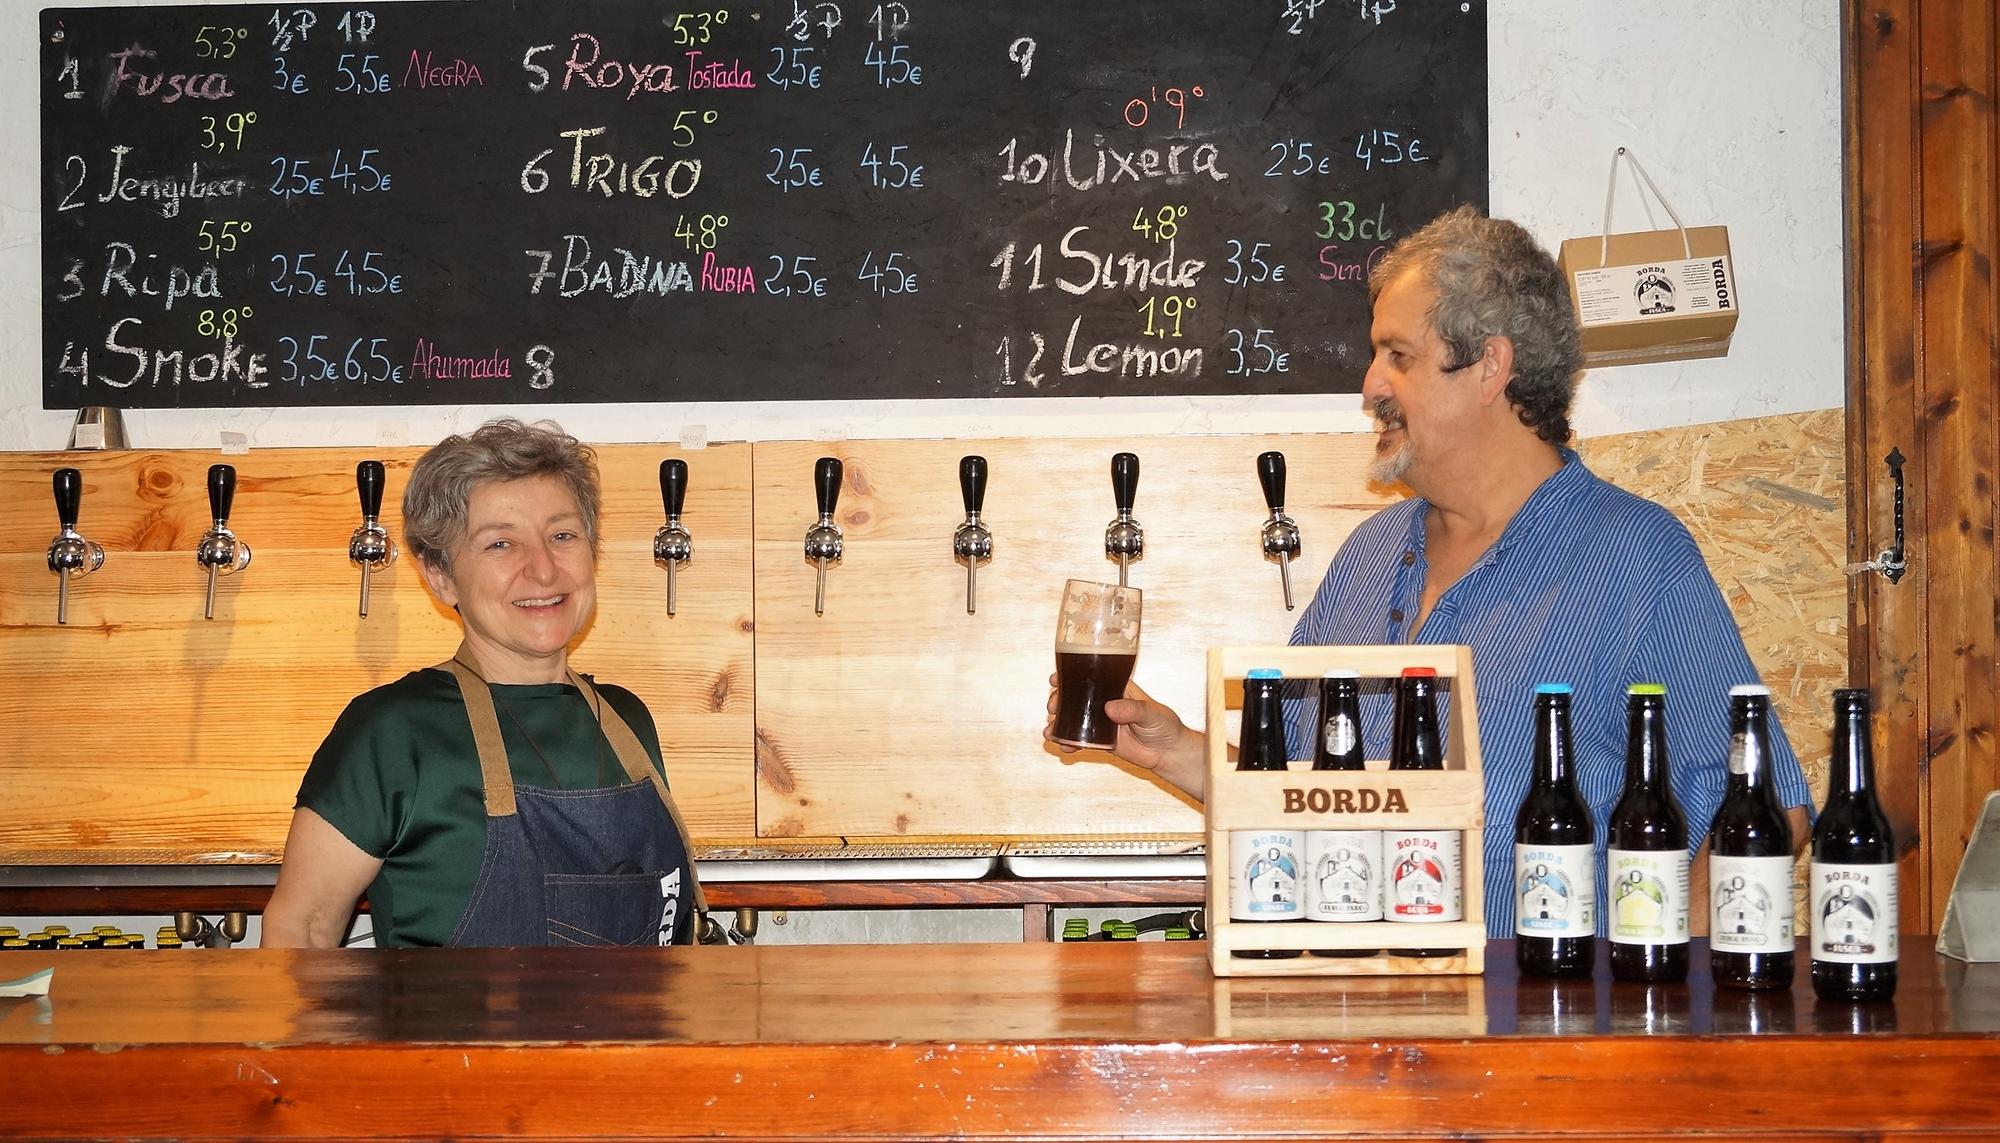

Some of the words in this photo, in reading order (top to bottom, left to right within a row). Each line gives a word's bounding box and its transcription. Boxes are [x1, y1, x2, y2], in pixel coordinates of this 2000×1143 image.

[58, 58, 84, 98] 1
[110, 43, 235, 104] Fusca
[273, 57, 309, 95] 3€
[335, 55, 391, 95] 5,5€
[403, 50, 483, 88] NEGRA
[522, 44, 555, 94] 5
[562, 32, 680, 101] Roya
[685, 51, 756, 91] Tostada
[766, 47, 822, 91] 2,5€
[863, 42, 922, 90] 4,5€
[58, 155, 87, 212] 2
[271, 156, 325, 197] 2,5€
[331, 149, 391, 195] 4,5€
[520, 149, 553, 195] 6
[560, 126, 702, 201] TRIGO
[766, 147, 824, 193] 2,5€
[859, 142, 924, 190] 4,5€
[1063, 128, 1230, 191] Lixera
[60, 258, 84, 302] 3
[100, 242, 223, 312] Ripa
[270, 254, 328, 298] 2,5€
[335, 249, 403, 297] 4,5€
[525, 249, 557, 295] 7
[701, 251, 757, 294] RUBIA
[764, 254, 828, 298] 2,5€
[858, 251, 920, 299] 4,5€
[1055, 225, 1207, 297] Sinde
[1224, 240, 1286, 289] 3,5€
[1318, 245, 1362, 282] Sin
[1636, 266, 1666, 277] BORDA
[1712, 258, 1730, 309] BORDA
[59, 341, 89, 388] 4
[279, 335, 339, 388] 3,5€
[344, 337, 404, 386] 6,5€
[409, 337, 512, 381] Ahumada
[525, 344, 555, 391] 8
[995, 332, 1046, 388] 12
[1061, 314, 1205, 378] Lemon
[1227, 329, 1291, 376] 3,5€
[1283, 788, 1409, 814] BORDA
[1252, 835, 1293, 848] BORDA
[1396, 837, 1439, 850] BORDA
[1825, 871, 1870, 885] BORDA
